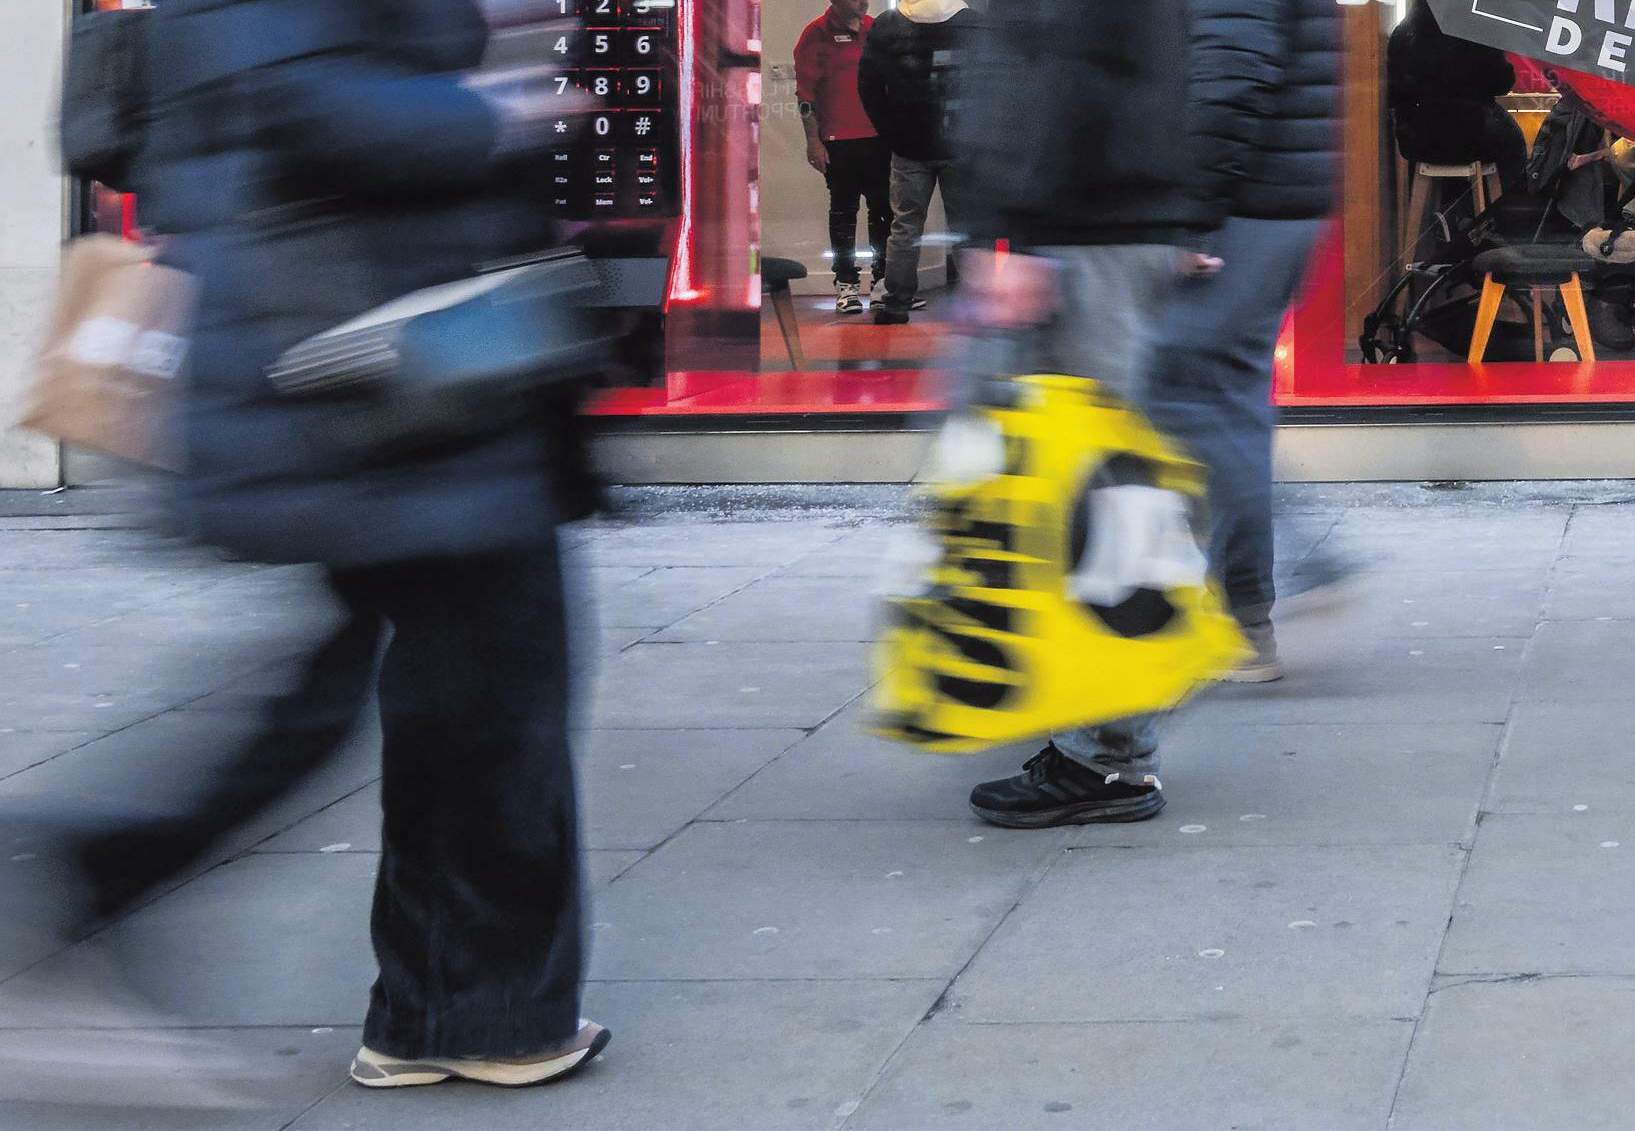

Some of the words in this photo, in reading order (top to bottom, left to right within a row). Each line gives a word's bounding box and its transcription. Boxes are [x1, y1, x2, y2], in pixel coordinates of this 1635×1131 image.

[553, 36, 568, 54] 4
[595, 35, 608, 53] 5
[637, 35, 651, 54] 6
[554, 77, 568, 95] 7
[595, 77, 609, 95] 8
[637, 76, 651, 95] 9
[595, 116, 609, 135] 0
[635, 116, 651, 135] #
[639, 154, 653, 162] End
